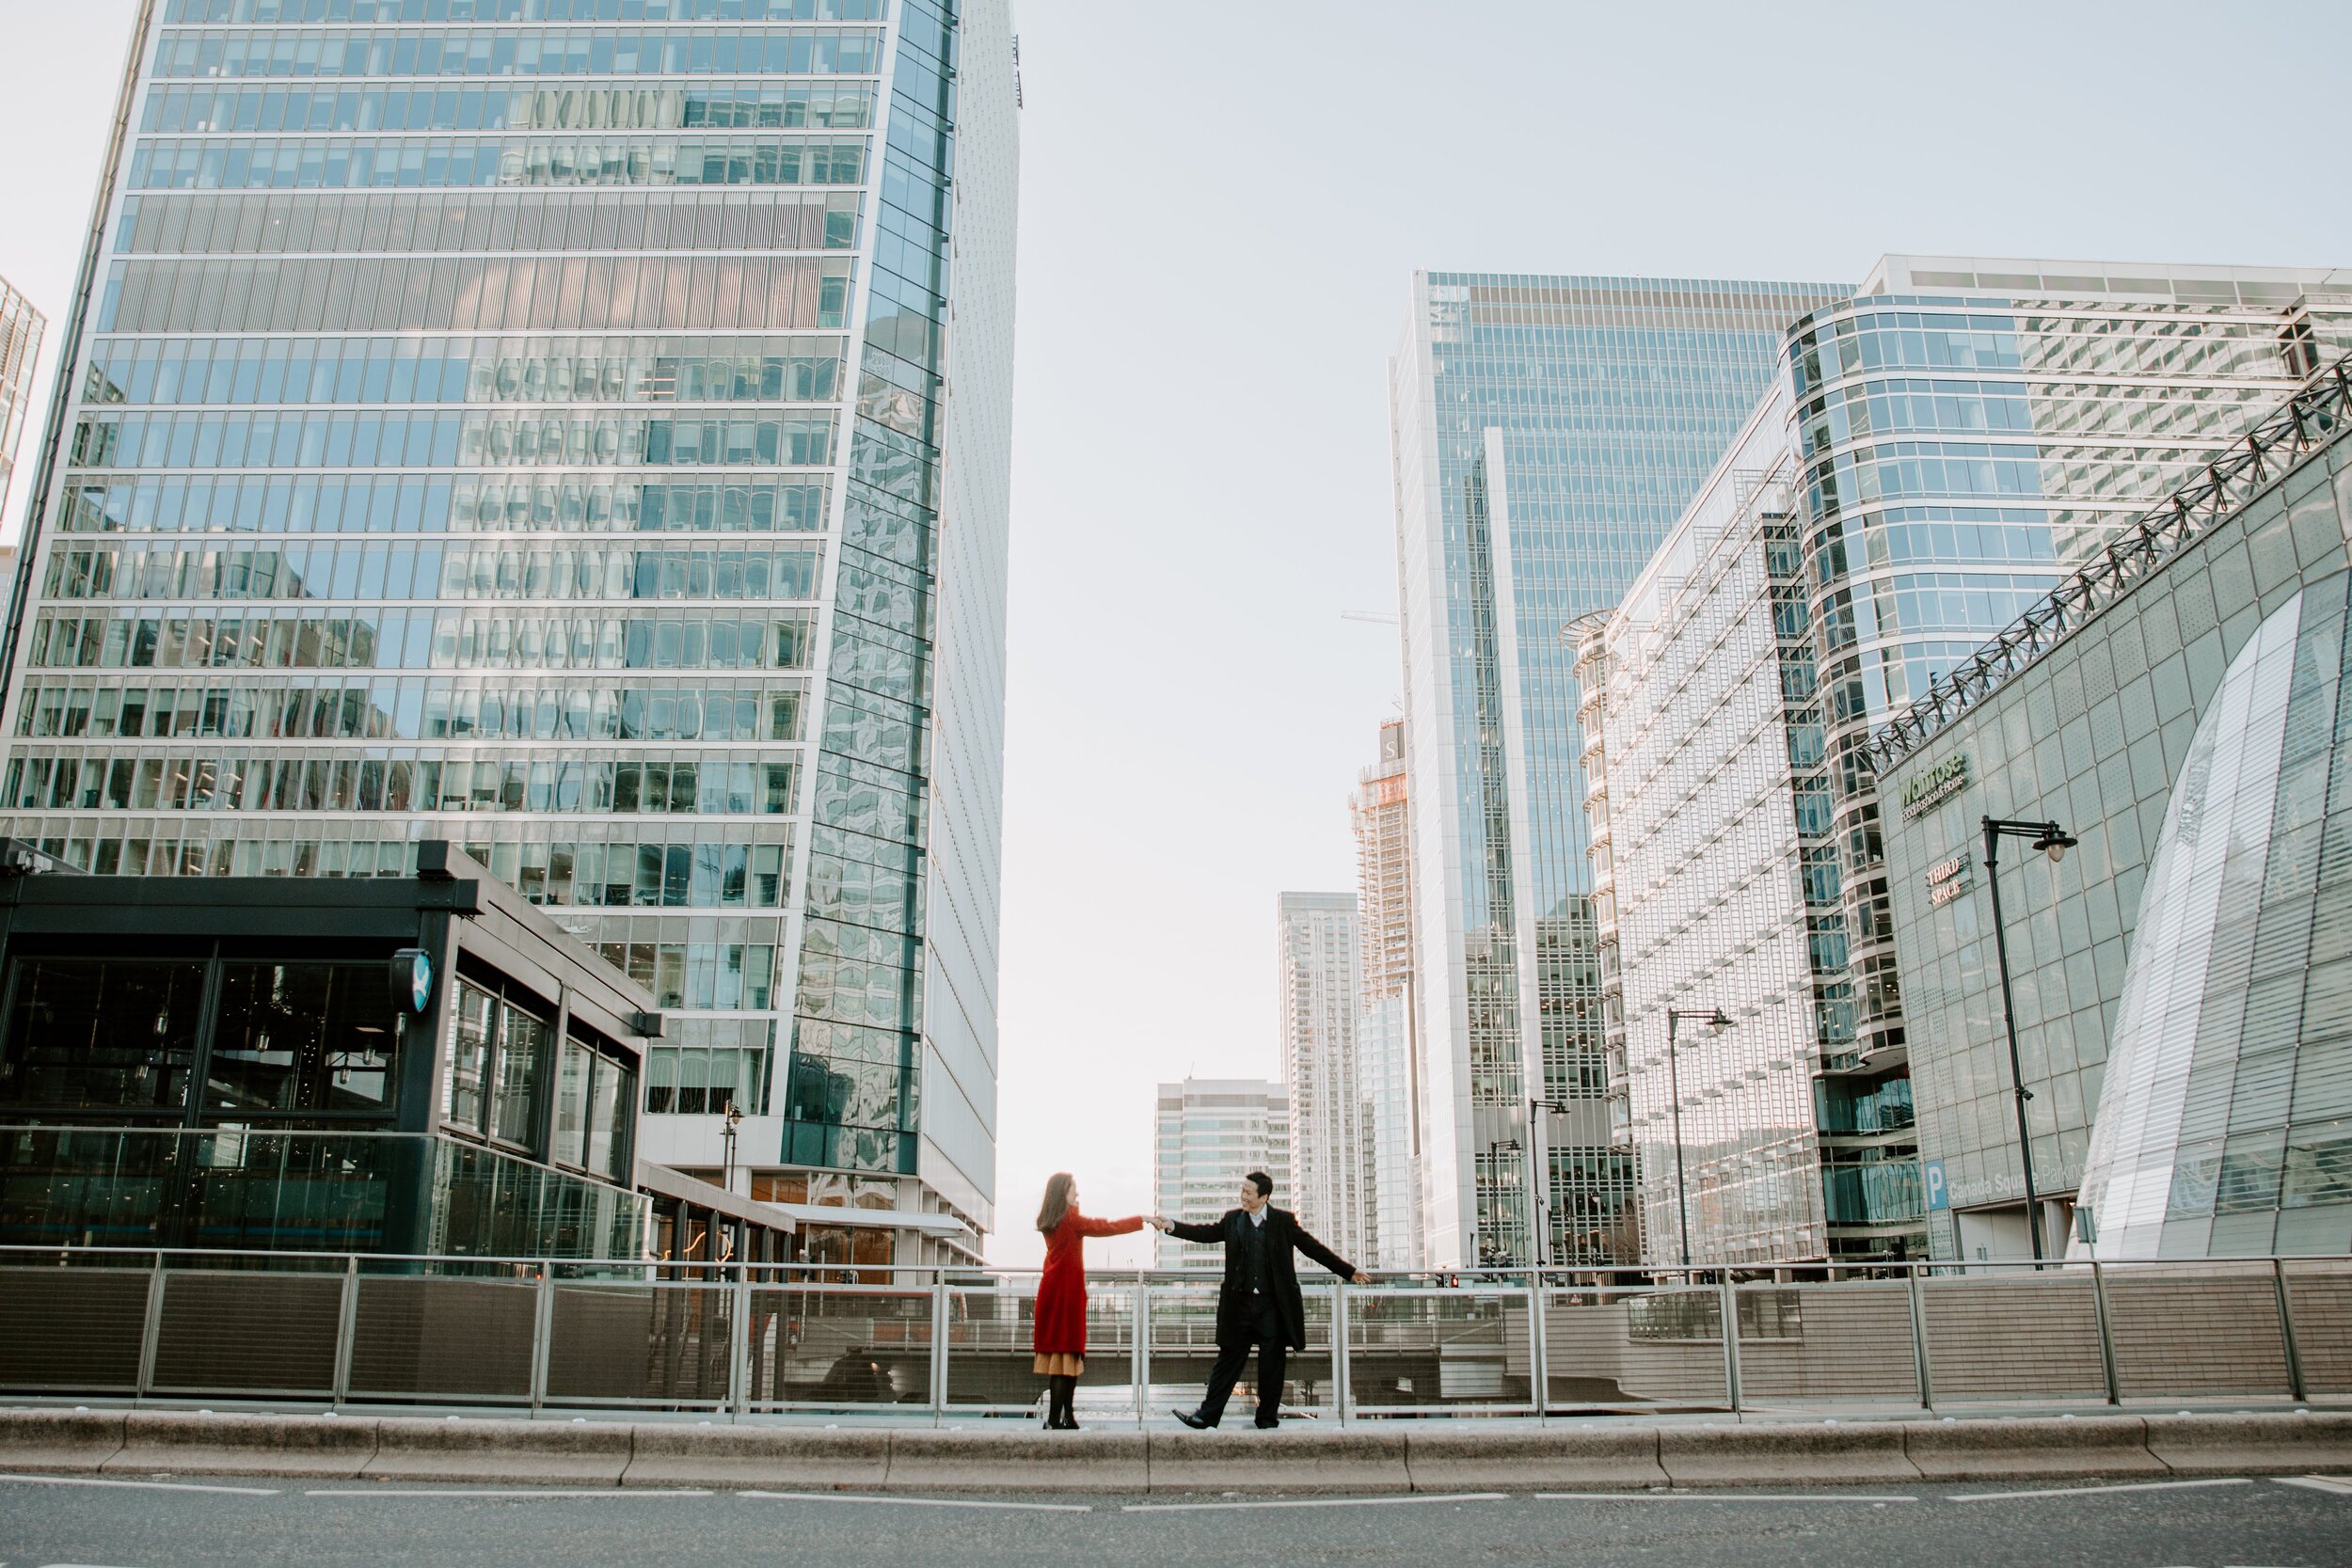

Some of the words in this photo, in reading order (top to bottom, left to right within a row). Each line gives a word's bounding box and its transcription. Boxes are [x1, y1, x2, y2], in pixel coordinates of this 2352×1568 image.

[1899, 753, 1963, 808] Waitrose
[1927, 858, 1960, 885] THIRD
[1931, 879, 1961, 905] SPACE
[1929, 1166, 1943, 1204] P
[1949, 1178, 1993, 1200] Canada
[1994, 1171, 2040, 1195] Squae
